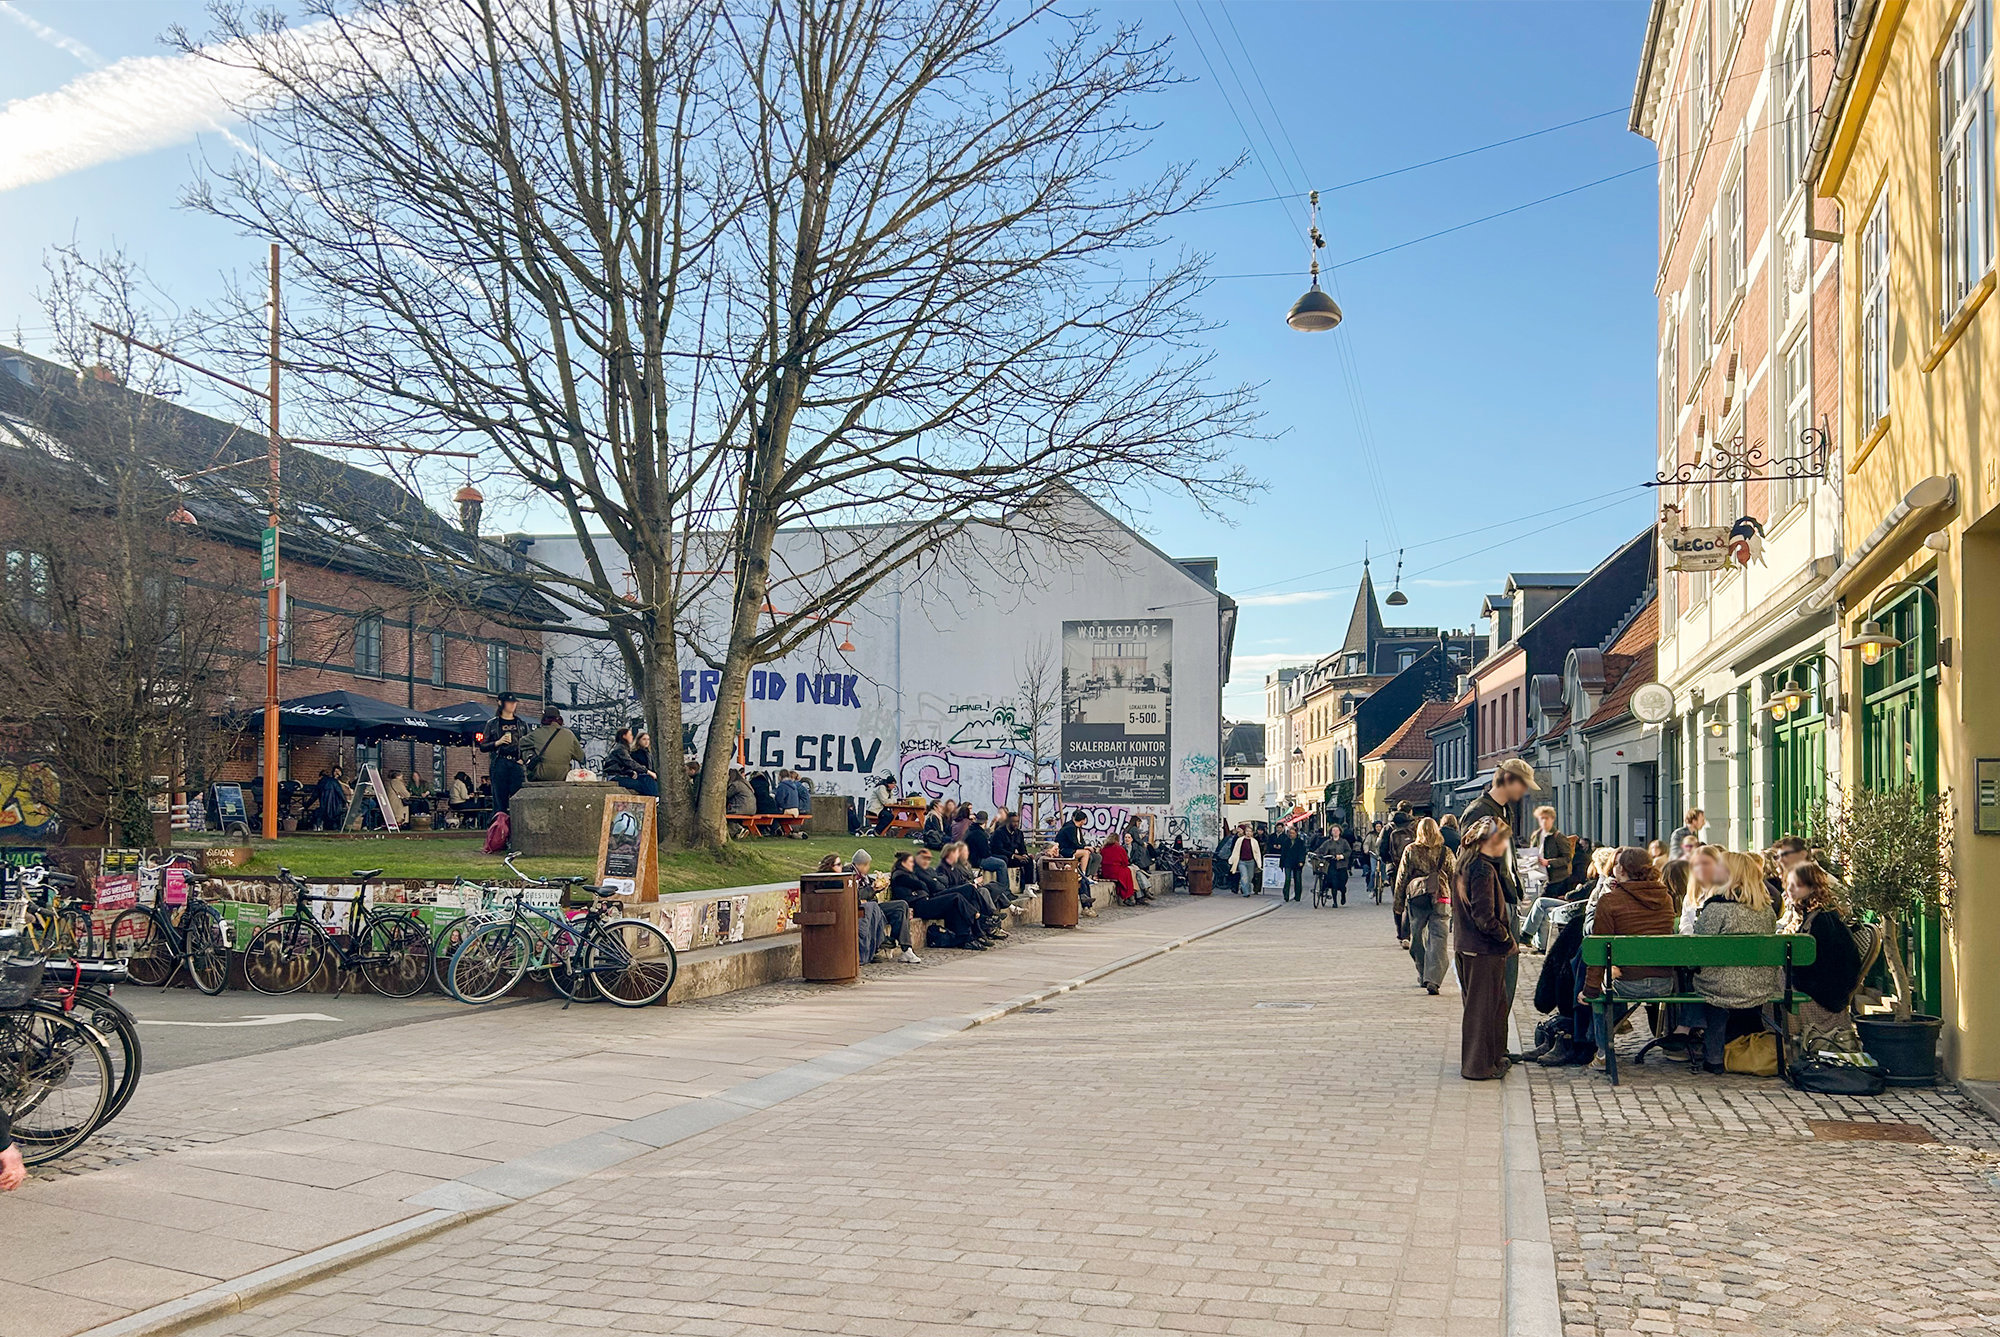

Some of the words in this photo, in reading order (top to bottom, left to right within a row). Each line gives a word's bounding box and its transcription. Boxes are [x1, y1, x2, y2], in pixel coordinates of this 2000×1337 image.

[1986, 457, 1996, 495] 14
[1077, 625, 1158, 639] WORKSPACE
[681, 669, 720, 703] ER
[752, 670, 787, 702] OD
[796, 672, 862, 710] NOK
[1129, 712, 1157, 724] 5-500
[794, 734, 883, 774] SELV
[1069, 741, 1128, 753] SKALERBART
[1129, 741, 1166, 753] KONTOR
[1159, 756, 1167, 767] V
[6, 852, 42, 868] VALG
